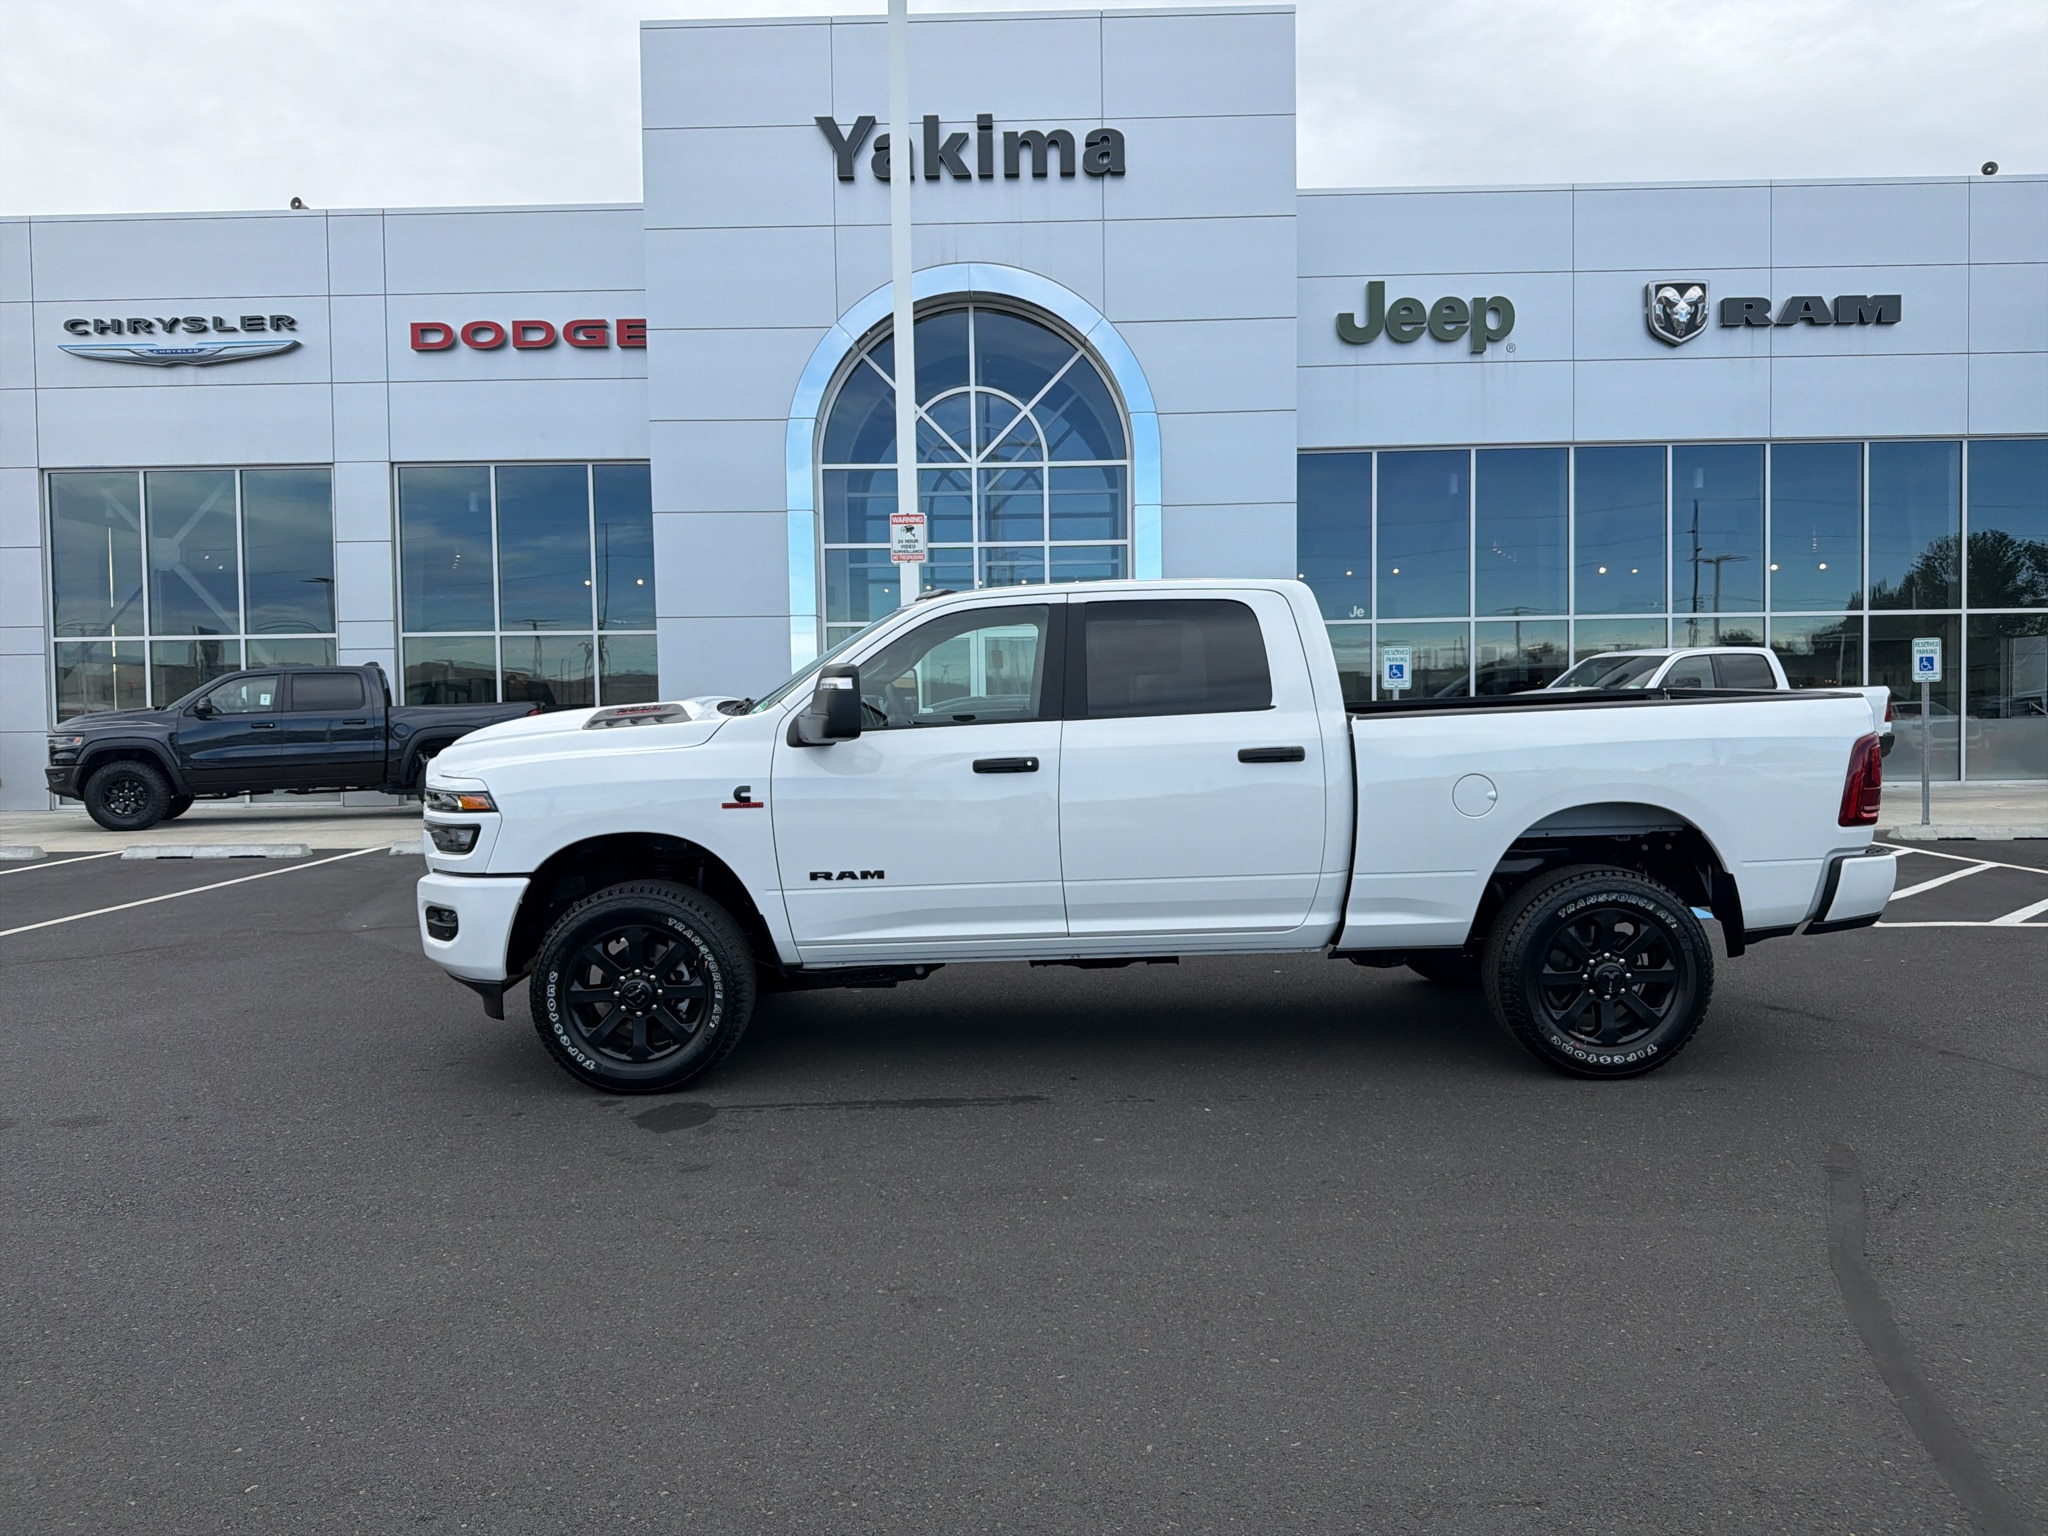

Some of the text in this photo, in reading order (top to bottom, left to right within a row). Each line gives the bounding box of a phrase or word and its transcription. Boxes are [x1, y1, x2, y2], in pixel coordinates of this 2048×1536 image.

[813, 113, 1126, 181] Yakima
[63, 314, 298, 336] CHRYSLER
[1336, 280, 1516, 355] Jeep
[1720, 294, 1902, 328] RAM
[410, 319, 647, 352] DODGE
[892, 516, 923, 524] WARNING
[1349, 605, 1365, 618] Je
[809, 870, 885, 881] RAM
[1558, 893, 1657, 919] TRANSFORCE
[667, 917, 724, 1000] TRANSFORCE
